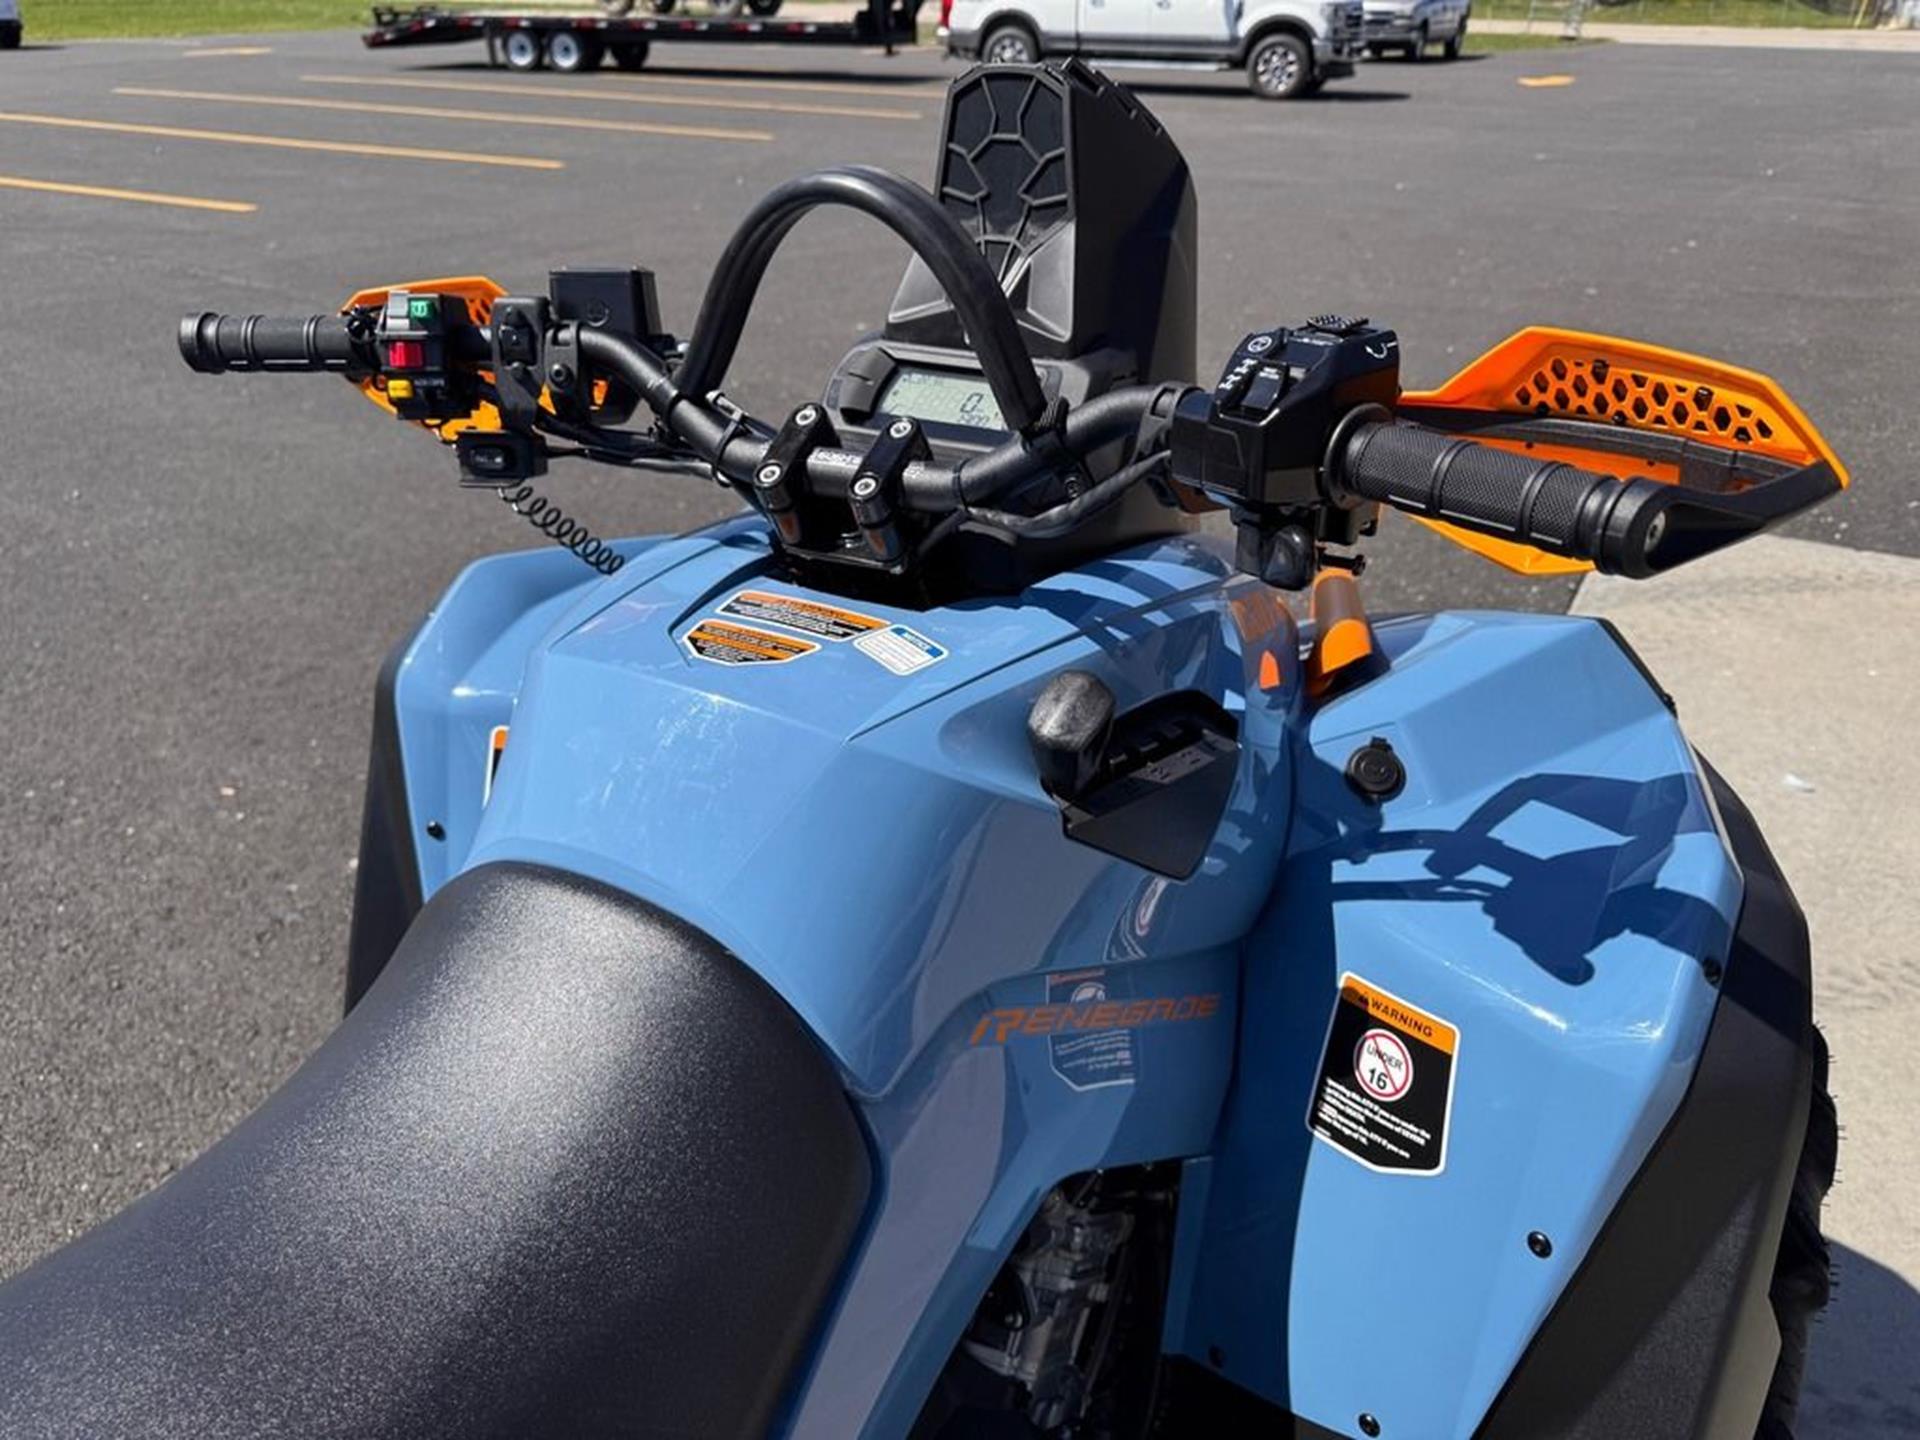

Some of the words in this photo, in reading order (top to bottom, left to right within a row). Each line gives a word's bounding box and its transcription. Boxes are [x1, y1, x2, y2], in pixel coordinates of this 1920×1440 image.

[970, 994, 1221, 1045] RENEGADE
[1370, 999, 1433, 1038] WARNING
[1366, 1044, 1404, 1072] UNDER
[1368, 1068, 1388, 1090] 16
